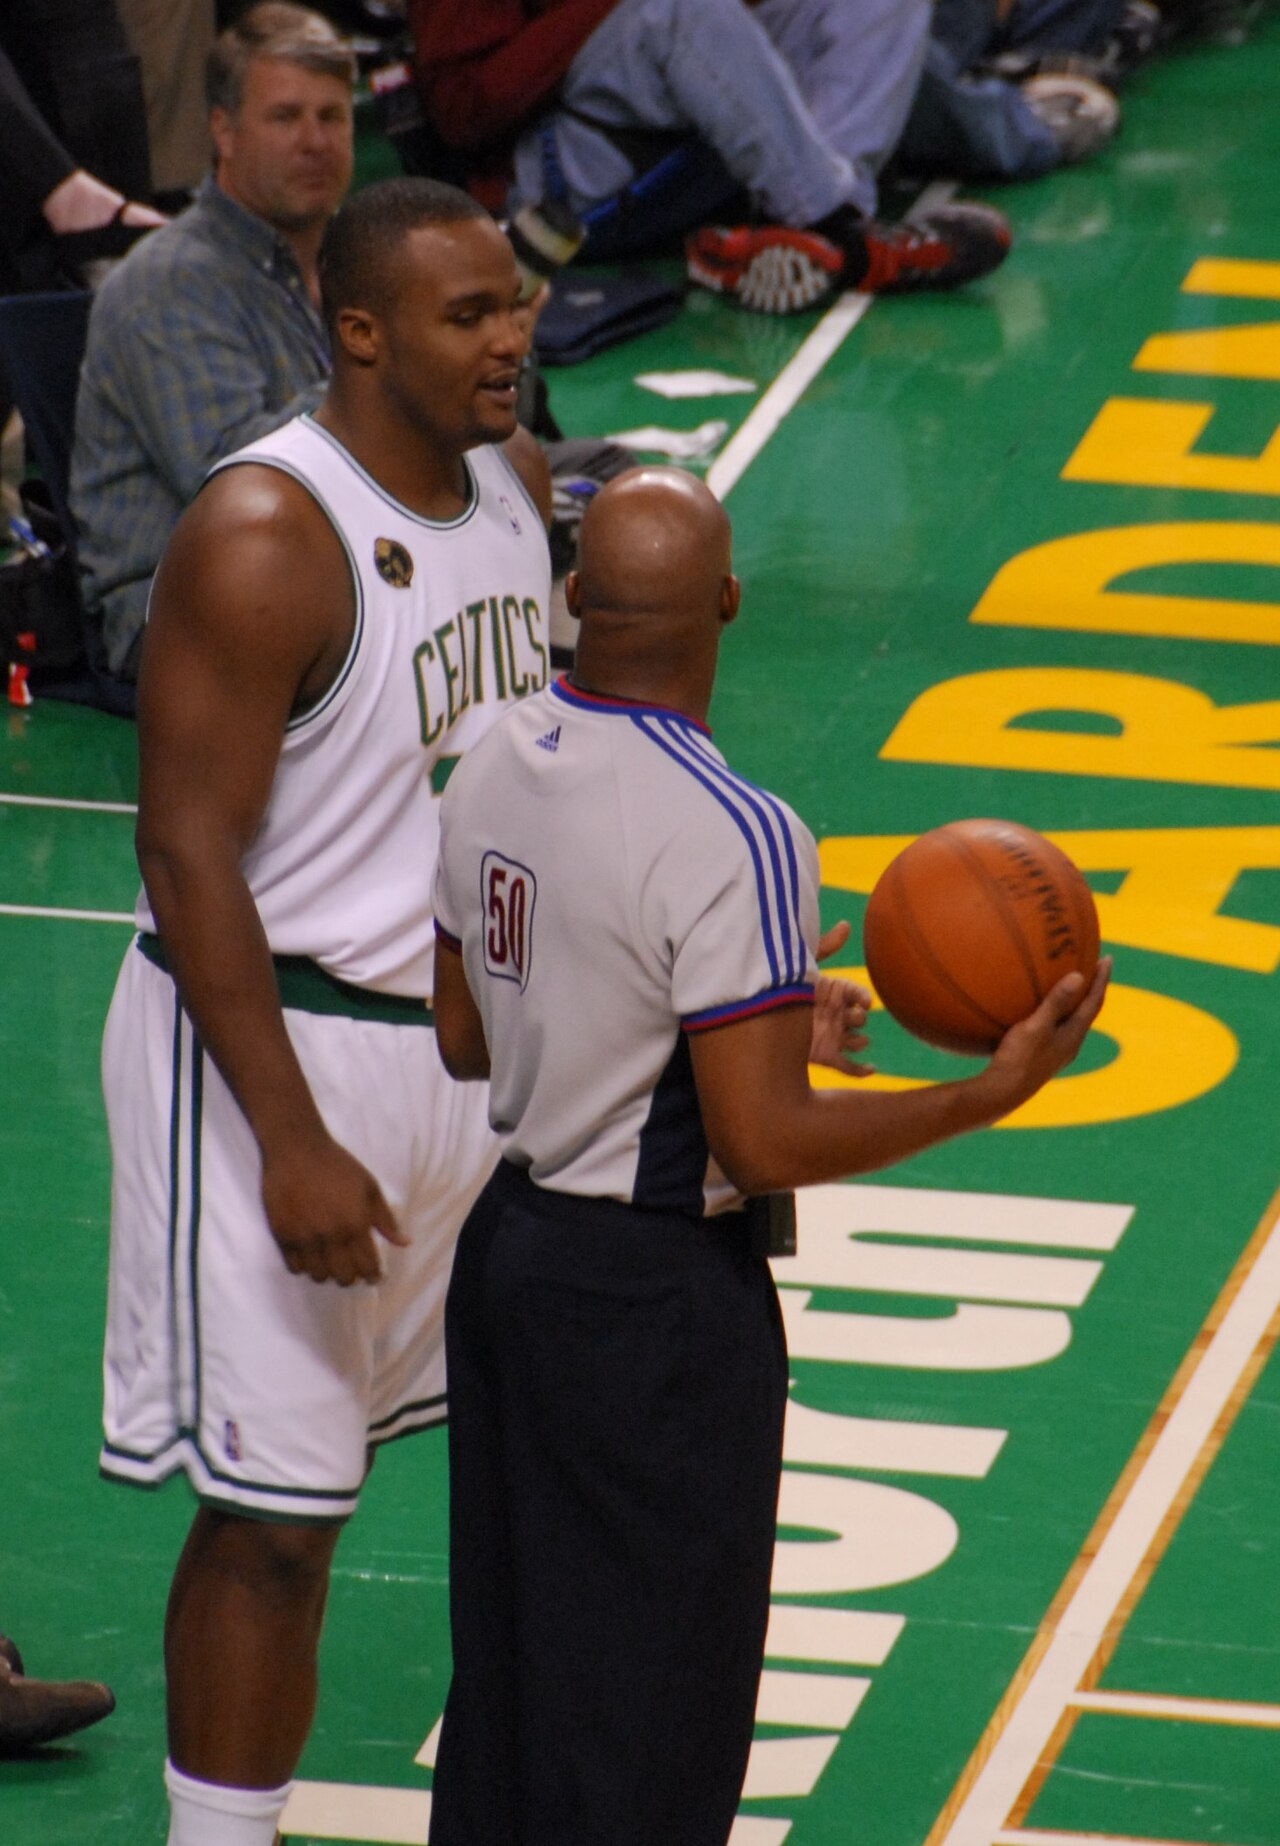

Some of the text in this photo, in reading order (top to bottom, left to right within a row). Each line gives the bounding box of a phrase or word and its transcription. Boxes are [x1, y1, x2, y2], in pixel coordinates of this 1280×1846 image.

[411, 593, 547, 747] CELTICS
[806, 258, 1280, 1130] GARD
[487, 866, 526, 977] 50
